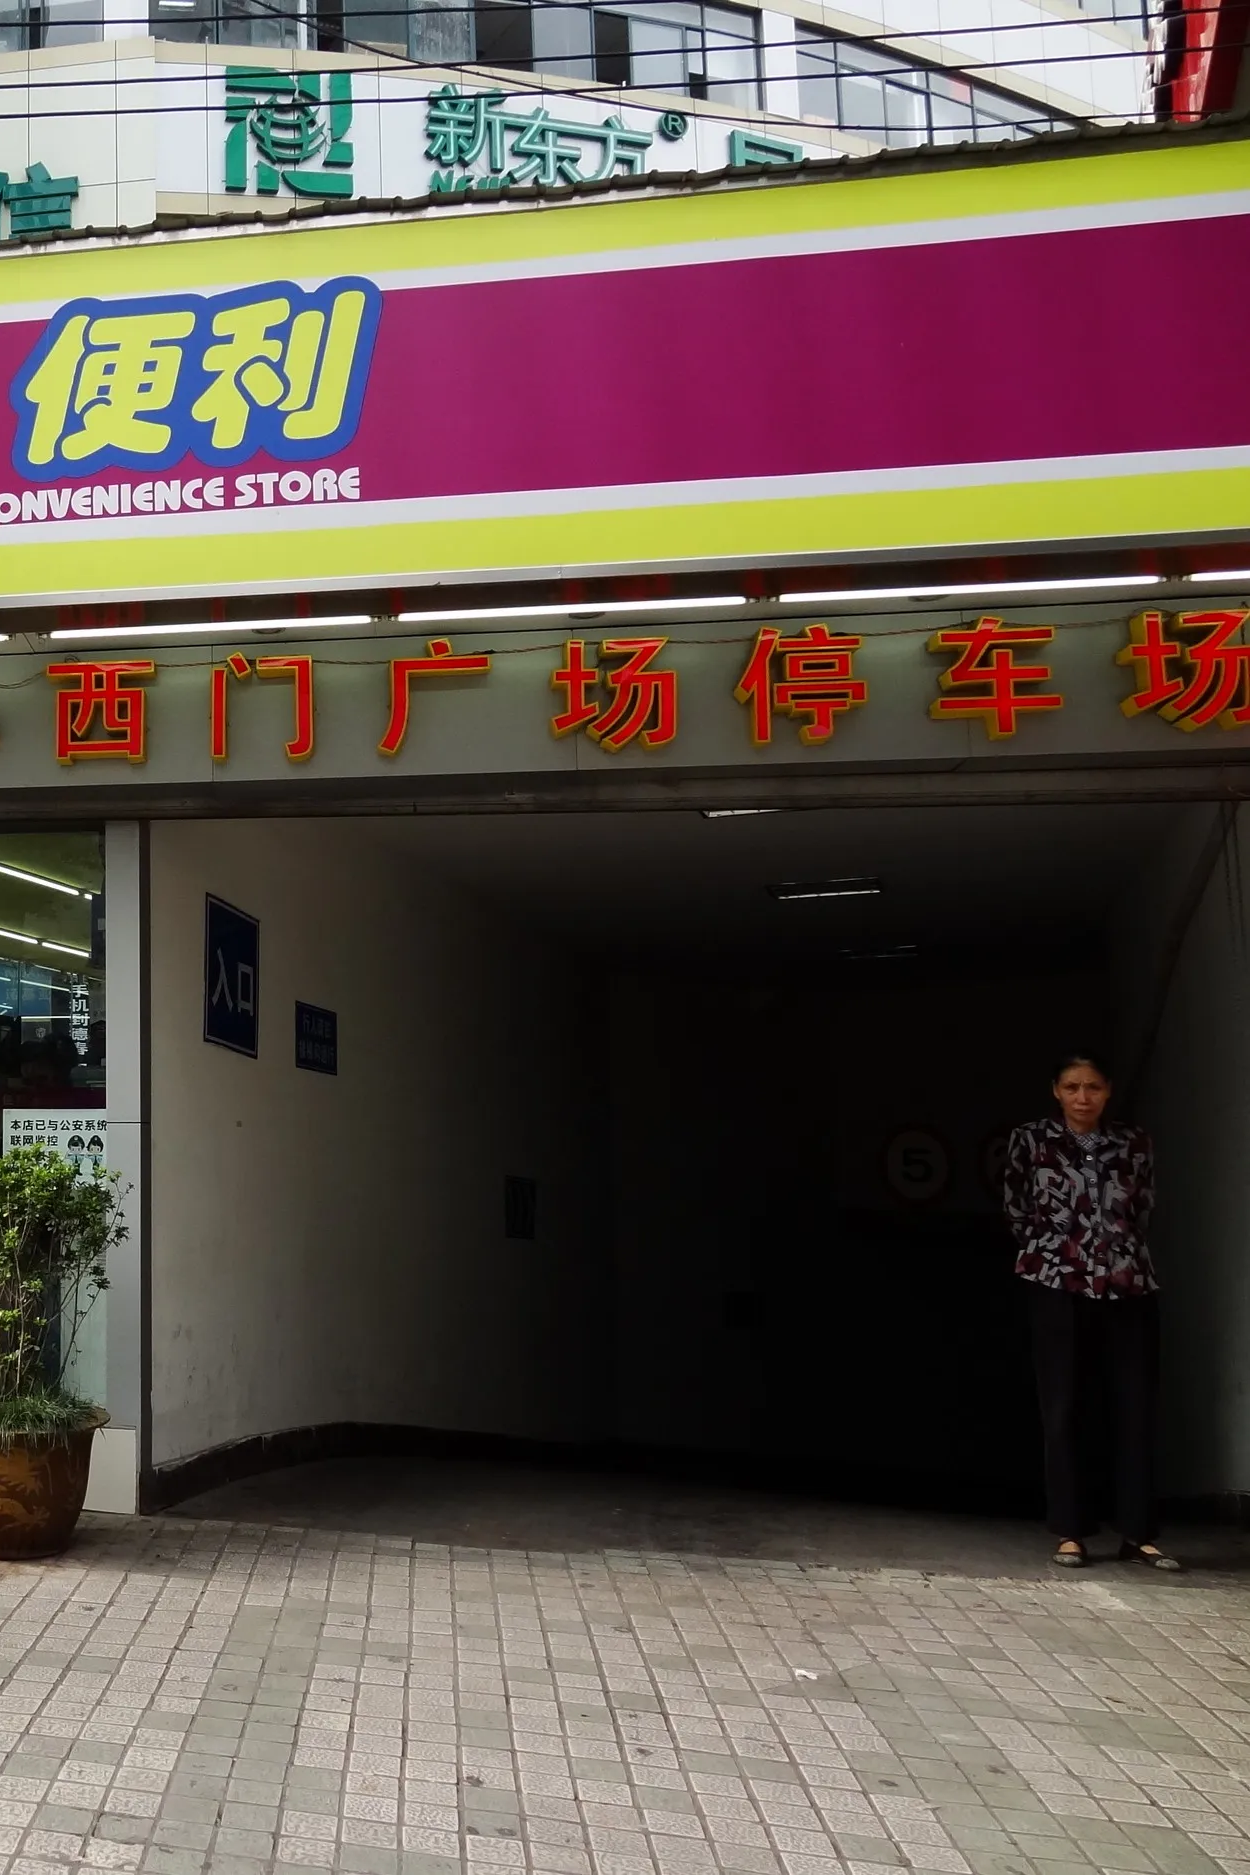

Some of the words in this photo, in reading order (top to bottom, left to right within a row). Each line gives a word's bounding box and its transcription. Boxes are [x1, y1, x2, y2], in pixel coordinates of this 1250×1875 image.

[426, 83, 653, 184] 新东方
[234, 466, 362, 509] STORE
[211, 947, 254, 1017] 入口
[10, 1119, 108, 1132] 本店已与公安系统
[902, 1147, 933, 1183] 5
